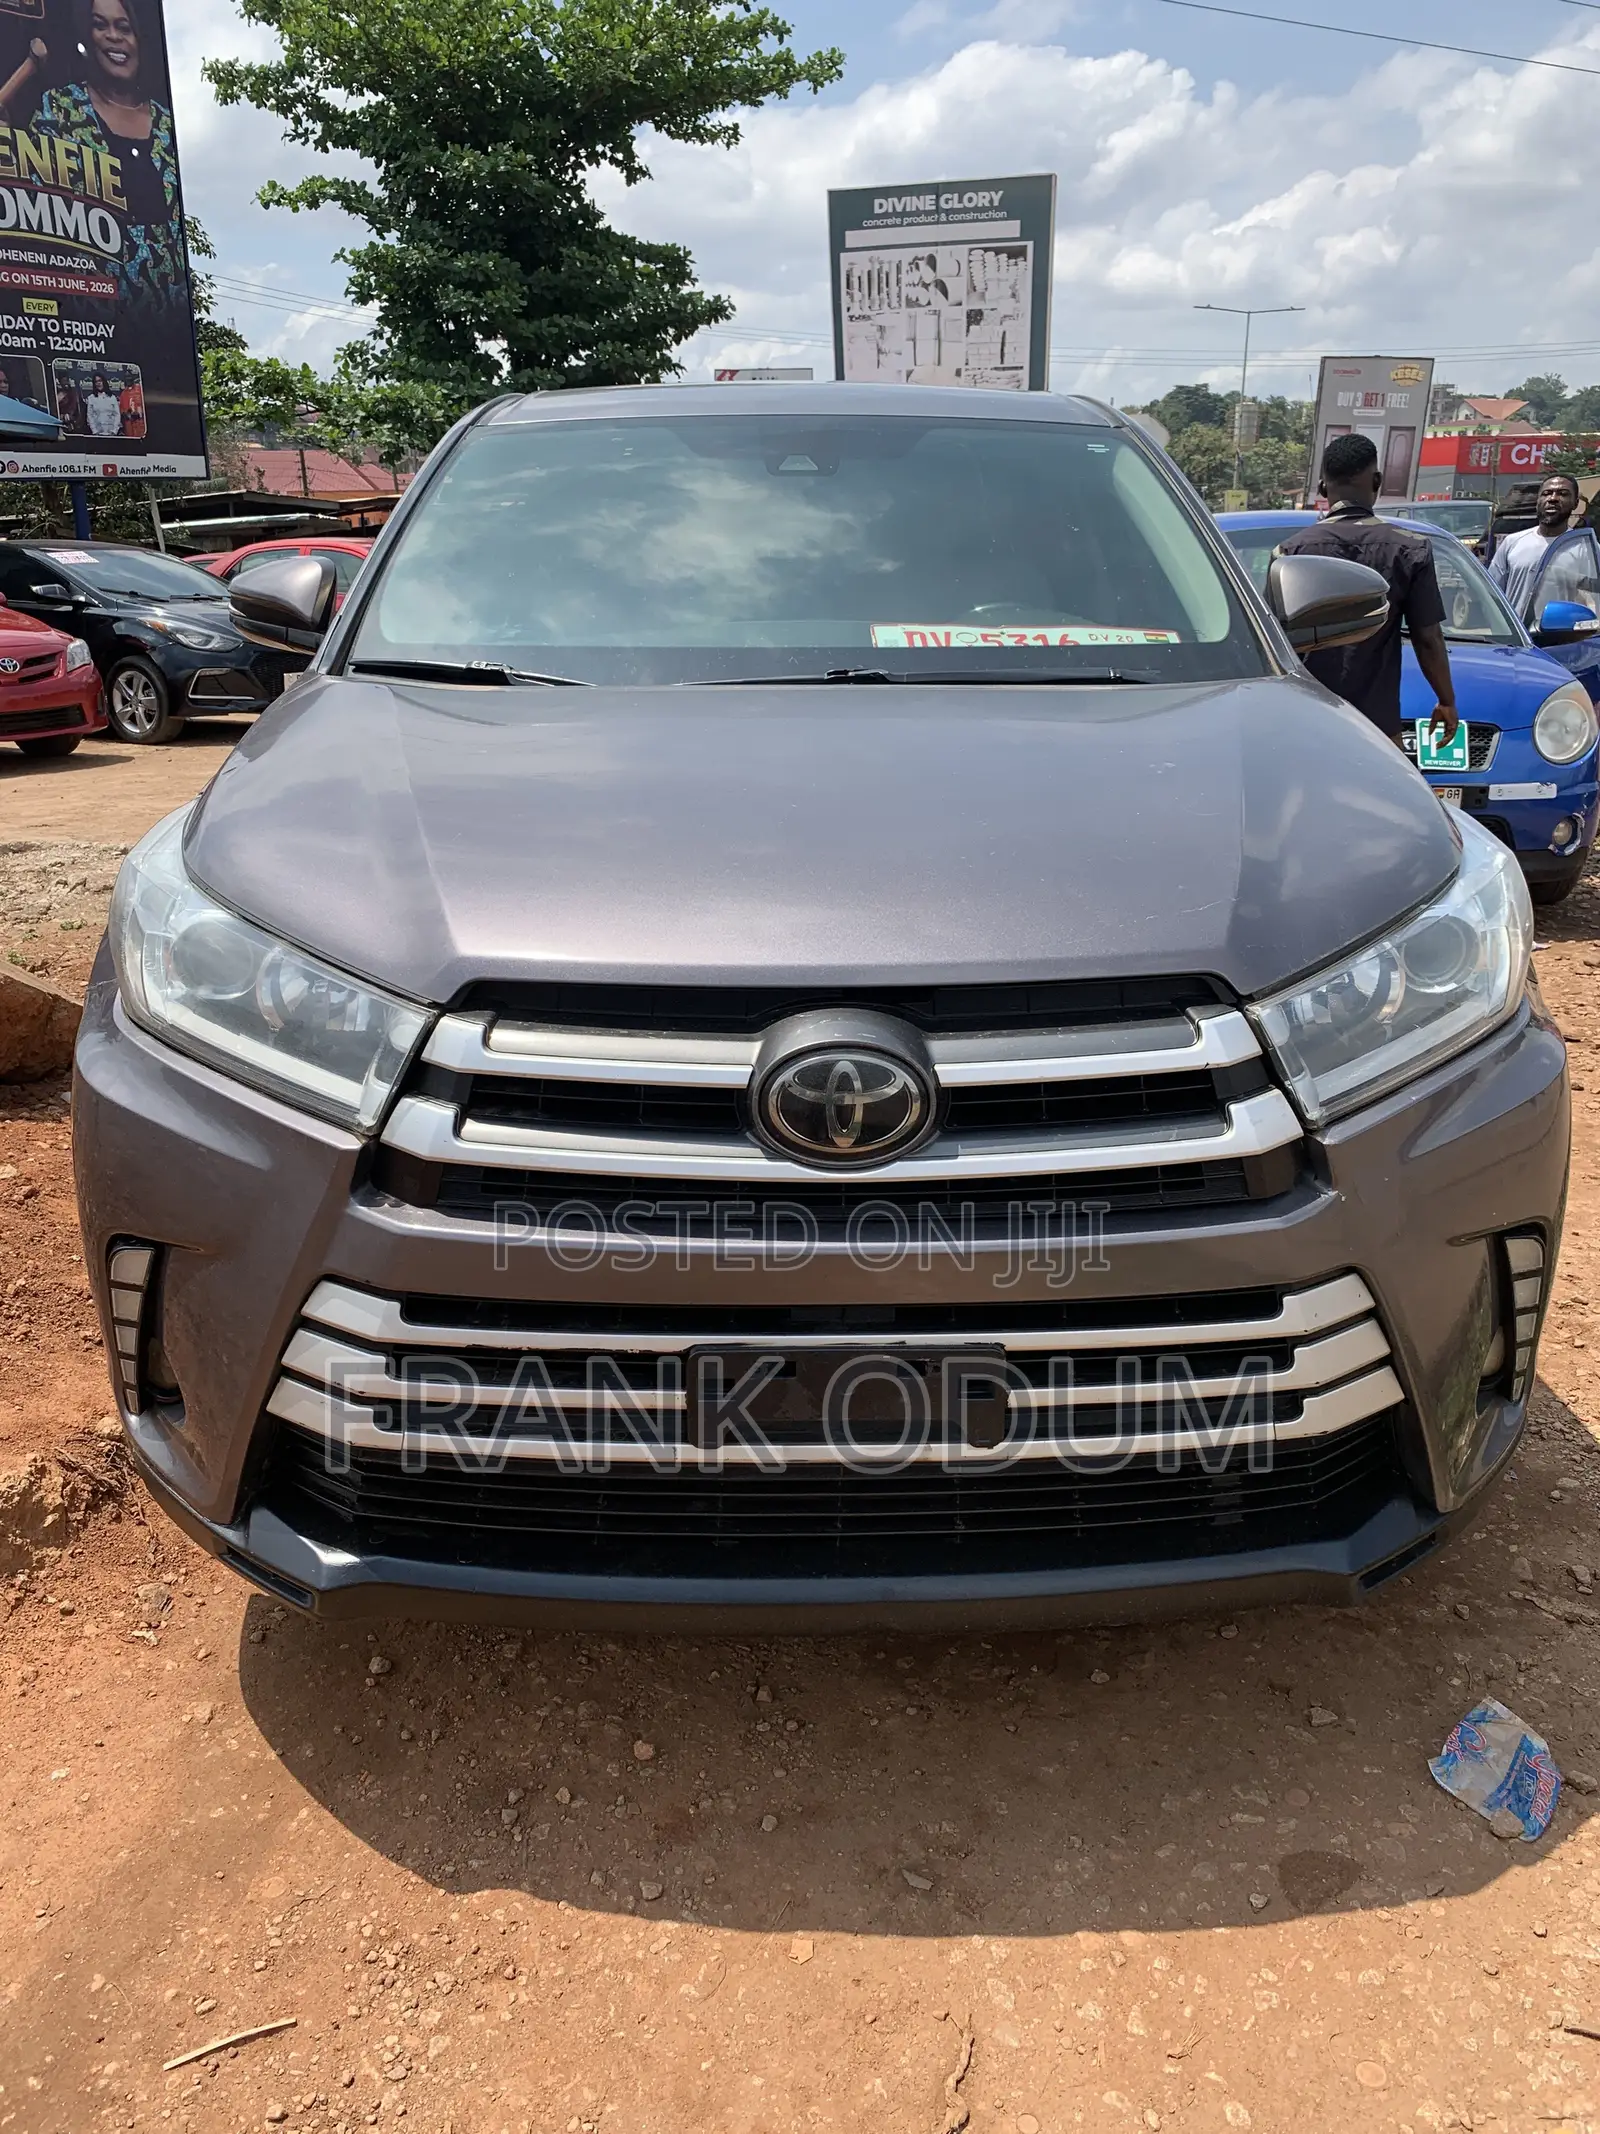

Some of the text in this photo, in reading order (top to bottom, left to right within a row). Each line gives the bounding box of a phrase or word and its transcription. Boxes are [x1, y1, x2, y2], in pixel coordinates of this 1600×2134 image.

[873, 190, 1004, 214] DIVINE GLORY
[862, 209, 1008, 227] concrete product & construction
[0, 248, 98, 270] HENENI ADAZOA
[11, 272, 29, 285] ON
[31, 274, 57, 288] 15TH
[58, 278, 89, 293] JUNE,
[90, 281, 115, 294] 2026
[26, 301, 55, 312] EVERY
[38, 318, 60, 333] TO
[63, 320, 115, 338] FRIDAY
[0, 332, 37, 349] 0am
[47, 335, 106, 354] 12:30PM
[1337, 391, 1355, 407] BUY
[1355, 391, 1363, 407] 3
[1363, 392, 1380, 408] GET
[1380, 392, 1386, 408] 1
[21, 464, 97, 474] Ahenfie 106.1 FM
[152, 464, 177, 474] Media
